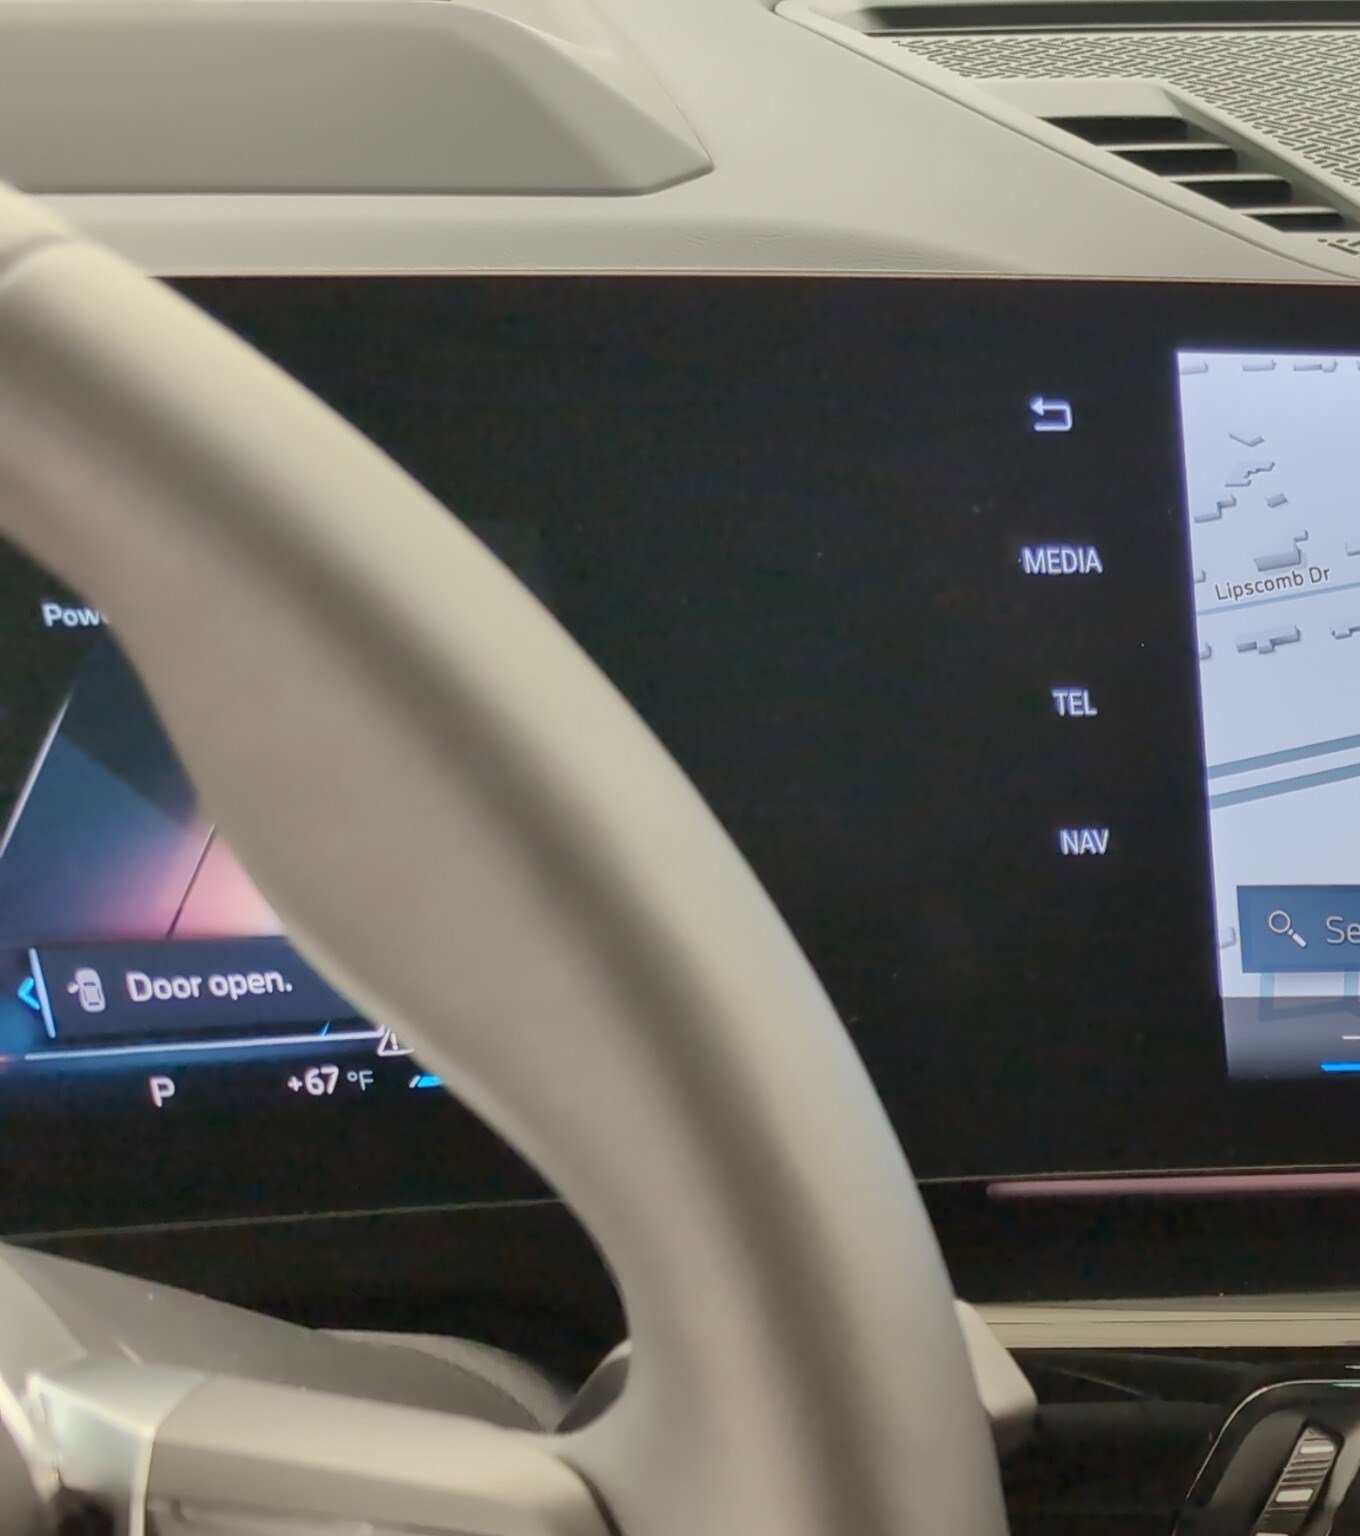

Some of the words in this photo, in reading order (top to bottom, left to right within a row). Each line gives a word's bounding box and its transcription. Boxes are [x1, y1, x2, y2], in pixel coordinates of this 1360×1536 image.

[1021, 546, 1103, 574] MEDIA
[1214, 568, 1305, 602] Lipscomb
[1308, 565, 1332, 586] Dr
[41, 602, 109, 627] Pow
[1052, 688, 1098, 717] TEL
[1060, 828, 1109, 856] NAV
[125, 972, 203, 1002] Door
[208, 970, 293, 1001] open.
[149, 1076, 176, 1107] P
[287, 1065, 340, 1096] +67
